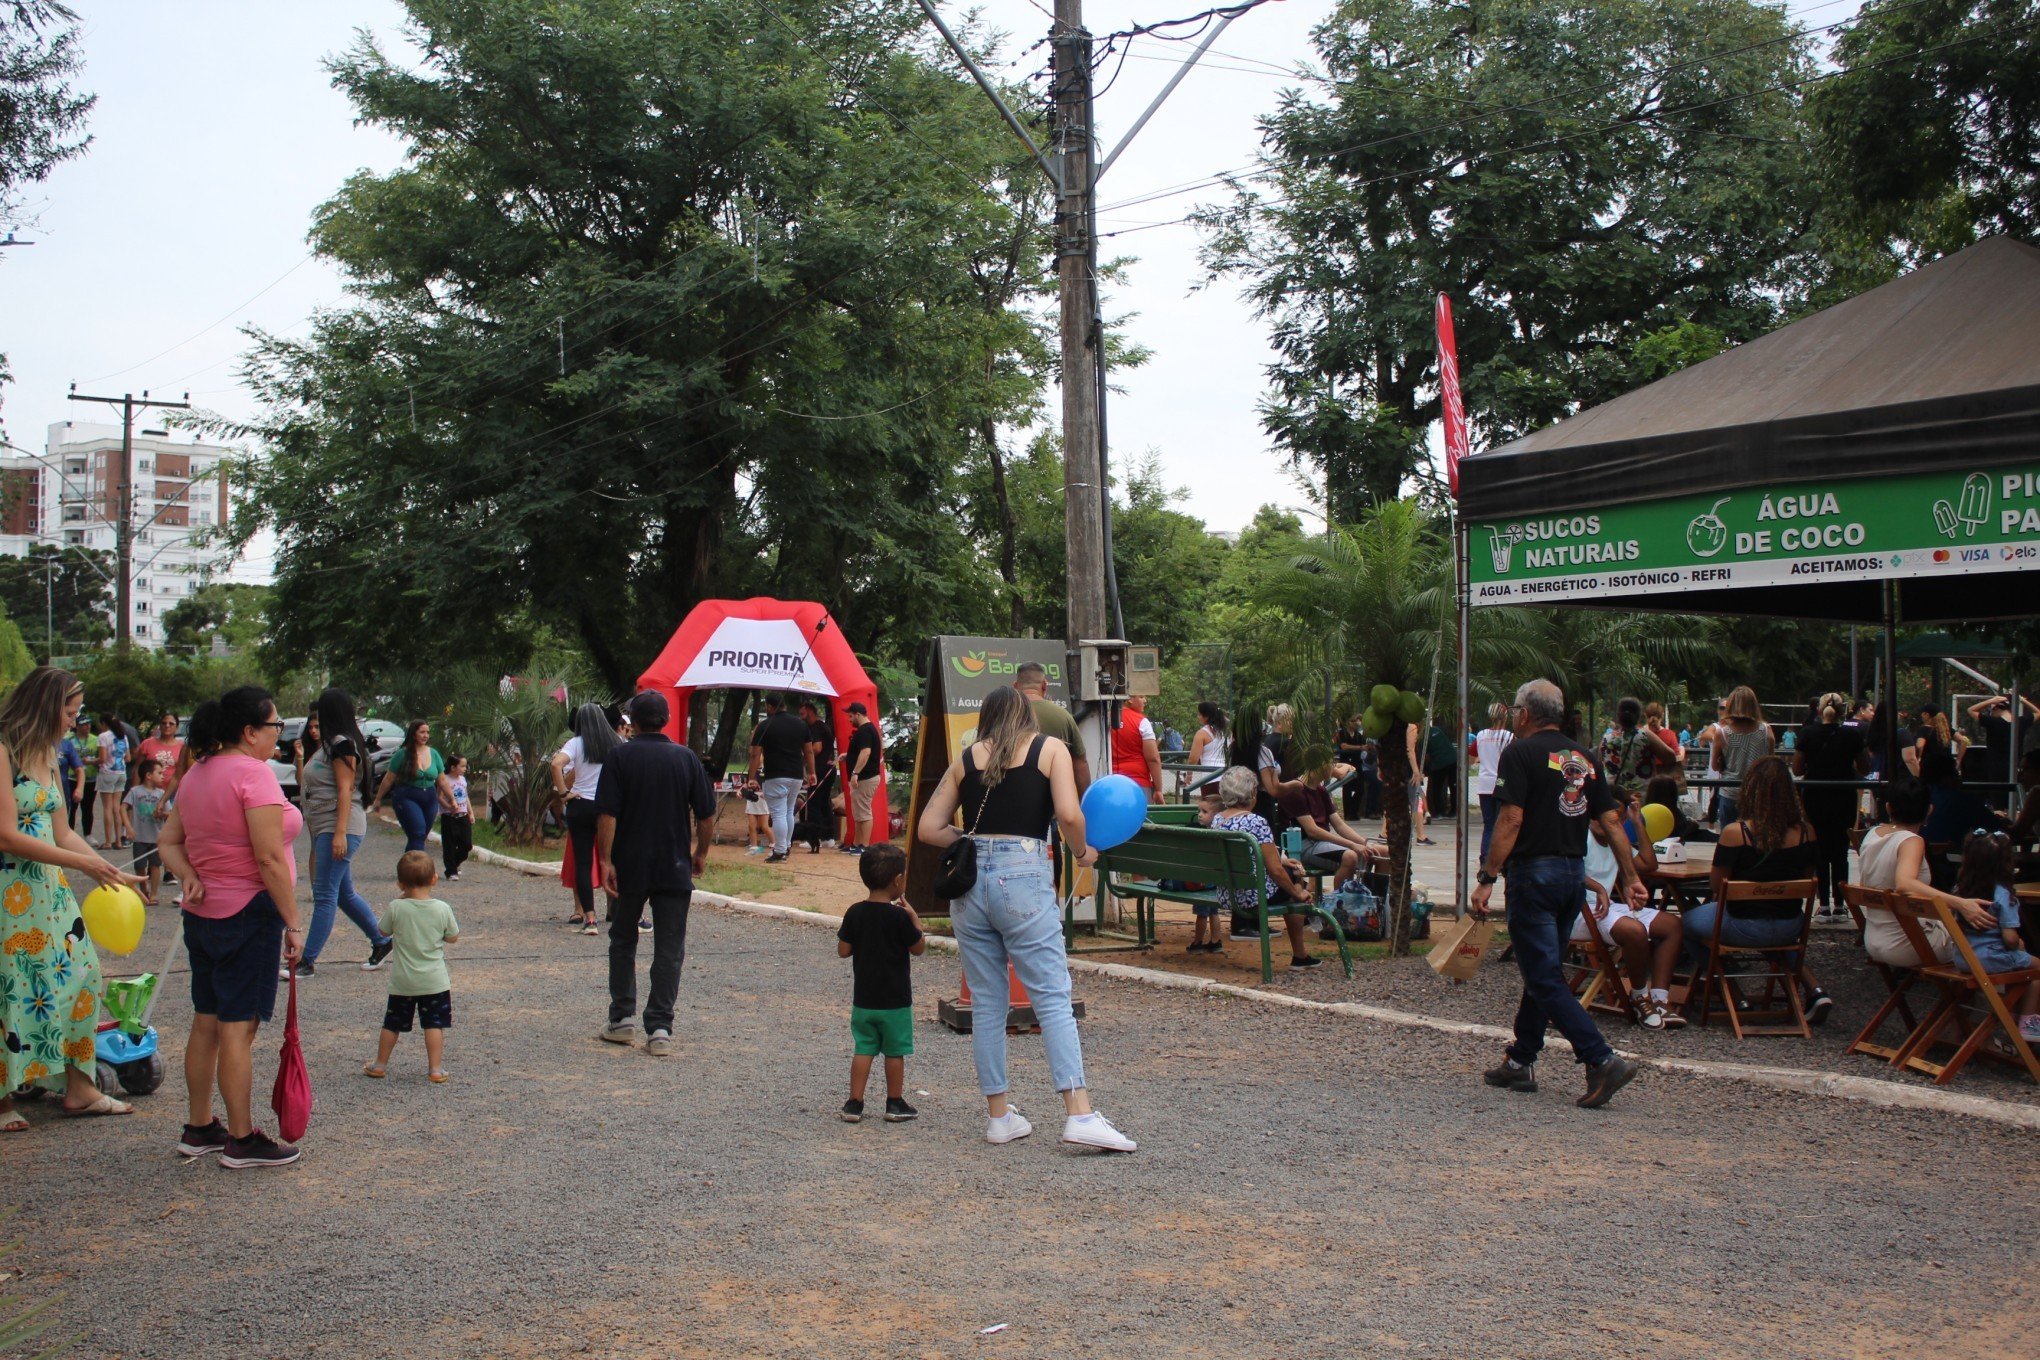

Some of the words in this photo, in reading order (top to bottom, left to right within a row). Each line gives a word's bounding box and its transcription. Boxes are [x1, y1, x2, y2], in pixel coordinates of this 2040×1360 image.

[2003, 473, 2040, 499] PI
[1756, 493, 1840, 521] ÁGUA
[1525, 515, 1601, 541] SUCOS
[1735, 531, 1771, 555] DE
[1781, 523, 1866, 550] COCO
[1526, 540, 1640, 569] NATURAIS
[1791, 558, 1884, 575] ACEITAMOS:
[1959, 548, 1990, 562] VISA
[1480, 585, 1511, 598] ÁGUA
[1521, 578, 1598, 595] ENERGÉTICO
[1609, 571, 1680, 588] ISOTÔNICO
[1692, 568, 1732, 583] REFRI
[708, 650, 804, 674] PRIORITÀ
